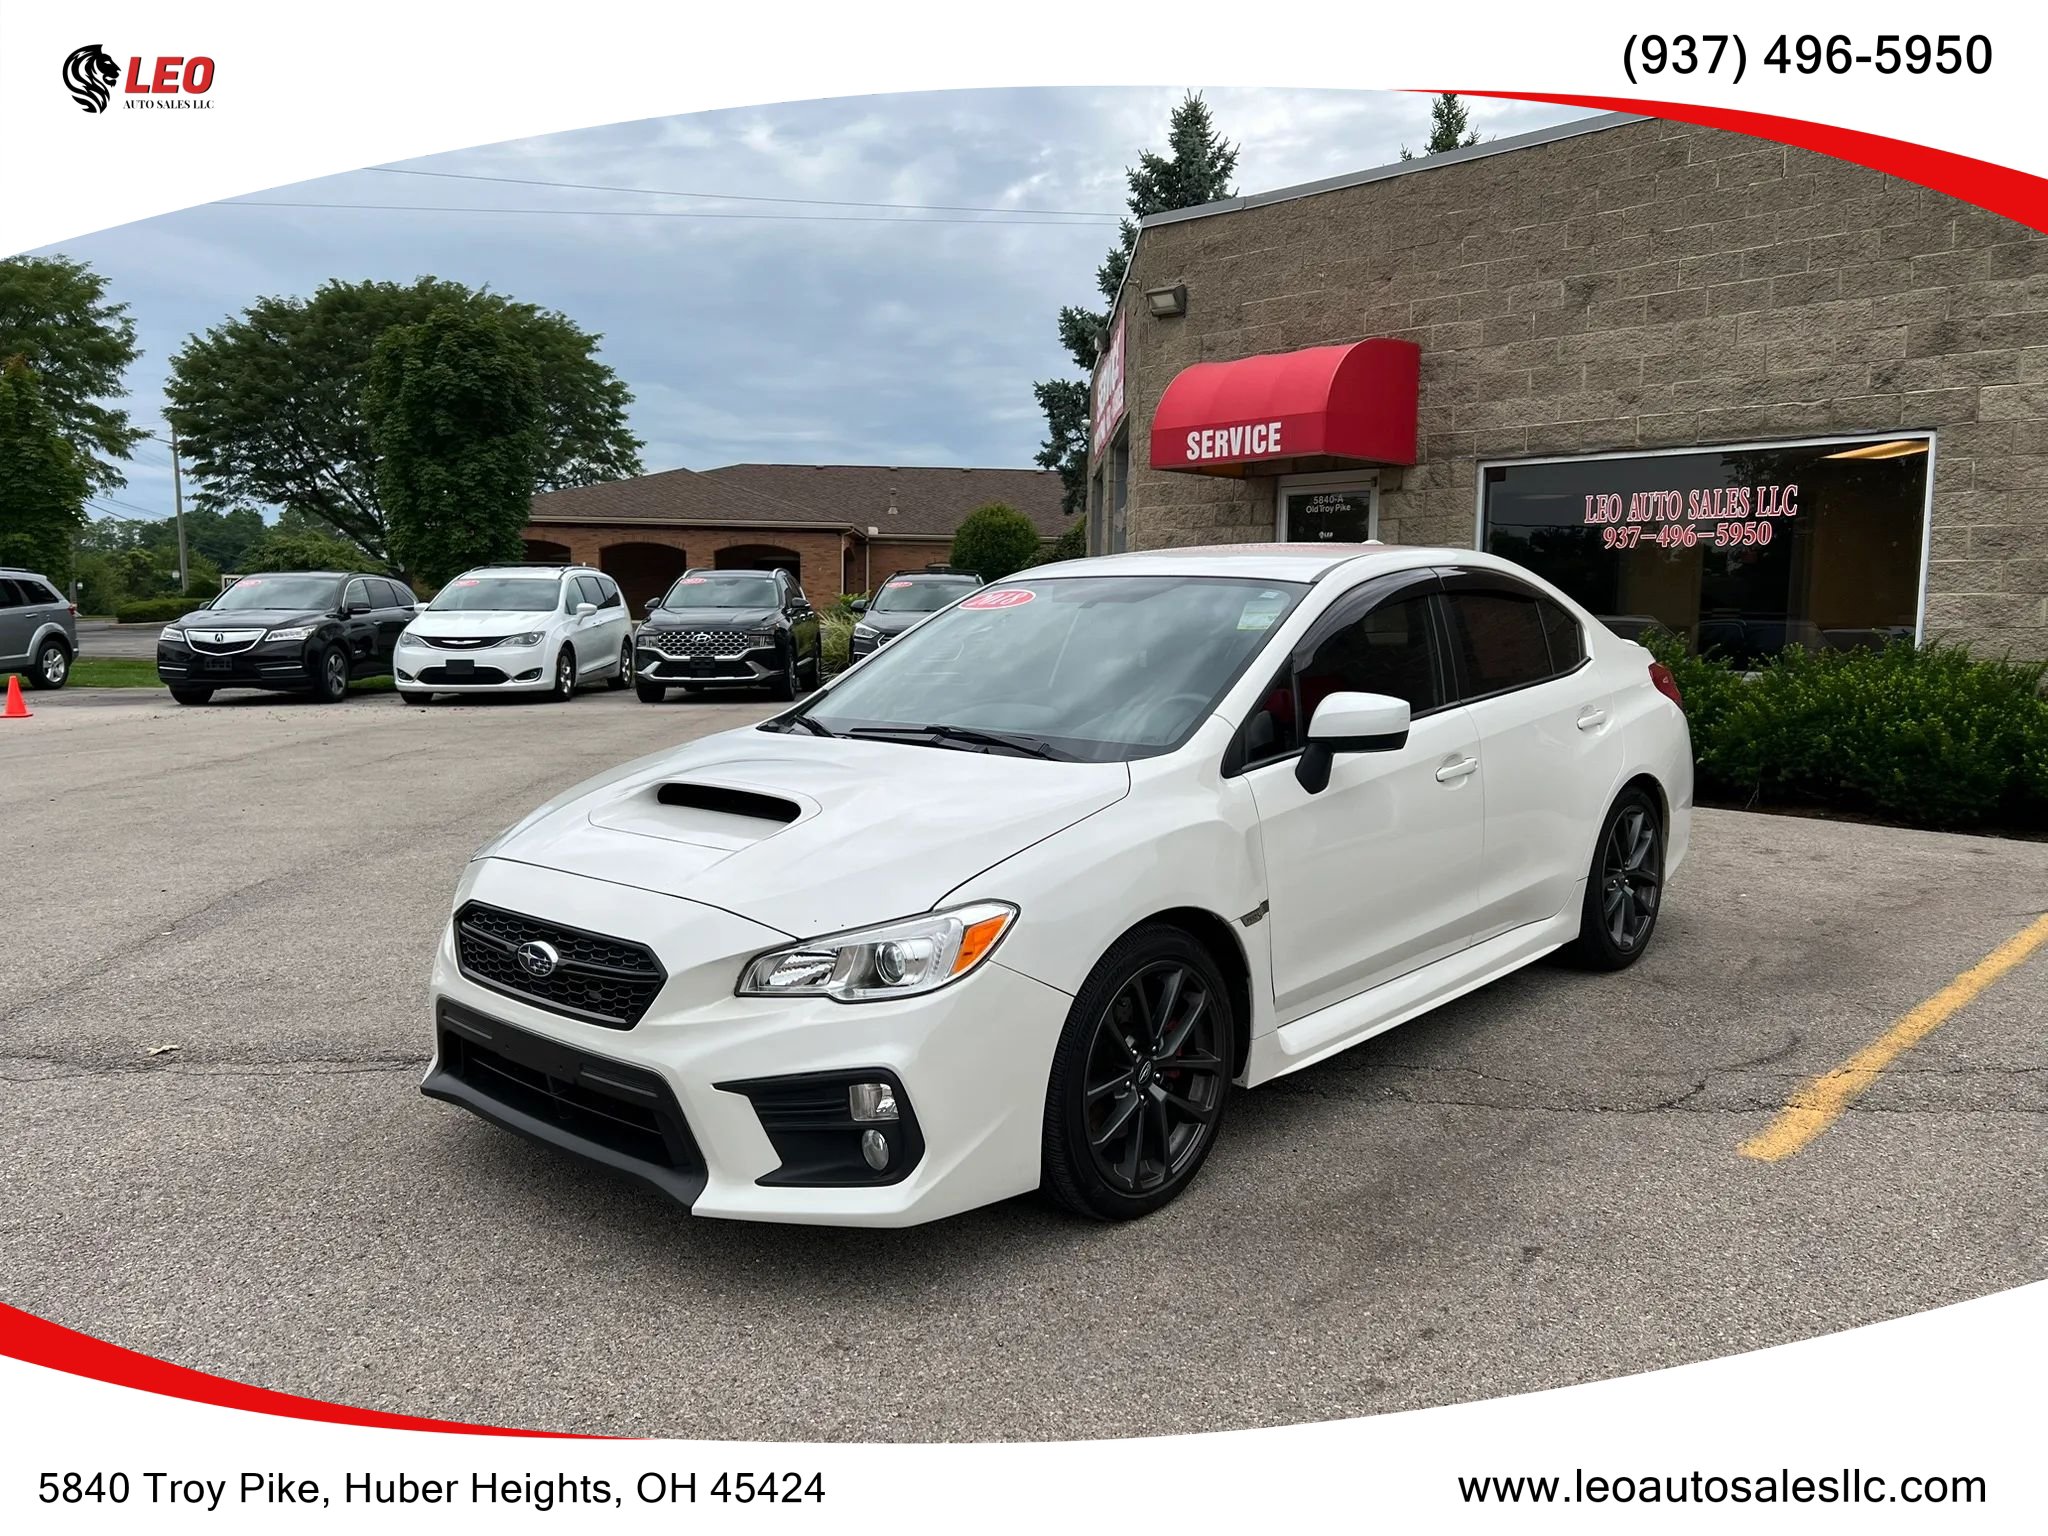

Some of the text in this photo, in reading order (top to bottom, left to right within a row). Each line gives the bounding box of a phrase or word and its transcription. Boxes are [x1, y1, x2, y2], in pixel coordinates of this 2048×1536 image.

[1186, 421, 1282, 461] SERVICE
[1306, 503, 1351, 514] Old Troy Pike
[1313, 494, 1344, 505] 5840-A
[1584, 484, 1799, 524] LEO AUTO SALES LLC
[1602, 520, 1773, 550] 937-496-5950
